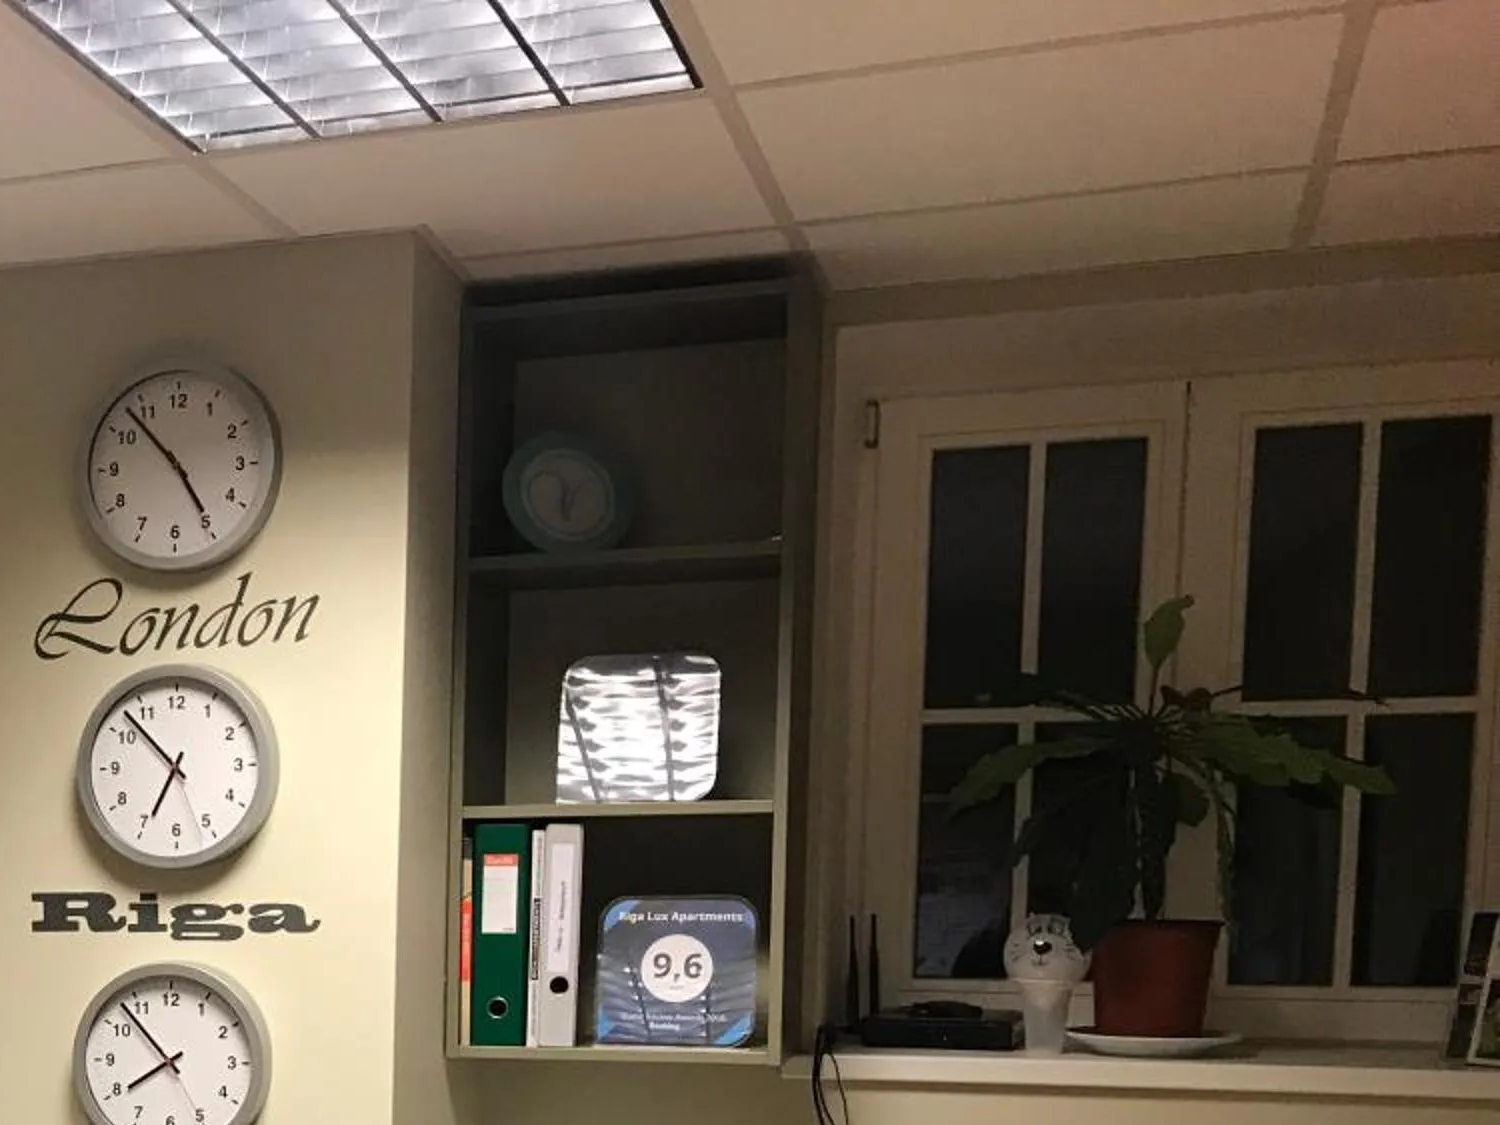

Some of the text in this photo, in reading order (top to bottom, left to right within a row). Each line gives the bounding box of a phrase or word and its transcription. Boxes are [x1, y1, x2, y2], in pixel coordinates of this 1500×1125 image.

[170, 394, 187, 408] 12
[141, 406, 155, 418] 11
[206, 402, 213, 415] 1
[118, 431, 136, 444] 10
[227, 424, 237, 439] 2
[109, 463, 119, 476] 9
[235, 457, 245, 470] 3
[116, 494, 125, 507] 8
[226, 488, 235, 502] 4
[137, 517, 147, 530] 7
[201, 516, 210, 529] 5
[170, 525, 180, 539] 6
[34, 572, 320, 660] London
[168, 696, 185, 710] 12
[140, 707, 154, 720] 11
[205, 705, 211, 718] 1
[118, 731, 136, 744] 10
[226, 727, 235, 740] 2
[110, 761, 120, 775] 9
[234, 758, 243, 772] 3
[118, 792, 127, 805] 8
[226, 788, 234, 802] 4
[139, 815, 148, 828] 7
[202, 814, 210, 828] 5
[172, 823, 181, 837] 6
[31, 893, 321, 941] Riga
[648, 911, 668, 922] Lux
[671, 911, 744, 923] Apartments
[653, 953, 703, 982] 9,6
[163, 993, 180, 1007] 12
[135, 1001, 148, 1014] 11
[198, 1003, 204, 1016] 1
[113, 1024, 130, 1037] 10
[219, 1026, 228, 1038] 2
[105, 1053, 115, 1067] 9
[228, 1056, 237, 1069] 3
[112, 1083, 121, 1096] 8
[219, 1086, 227, 1099] 4
[134, 1106, 143, 1119] 7
[196, 1109, 204, 1122] 5
